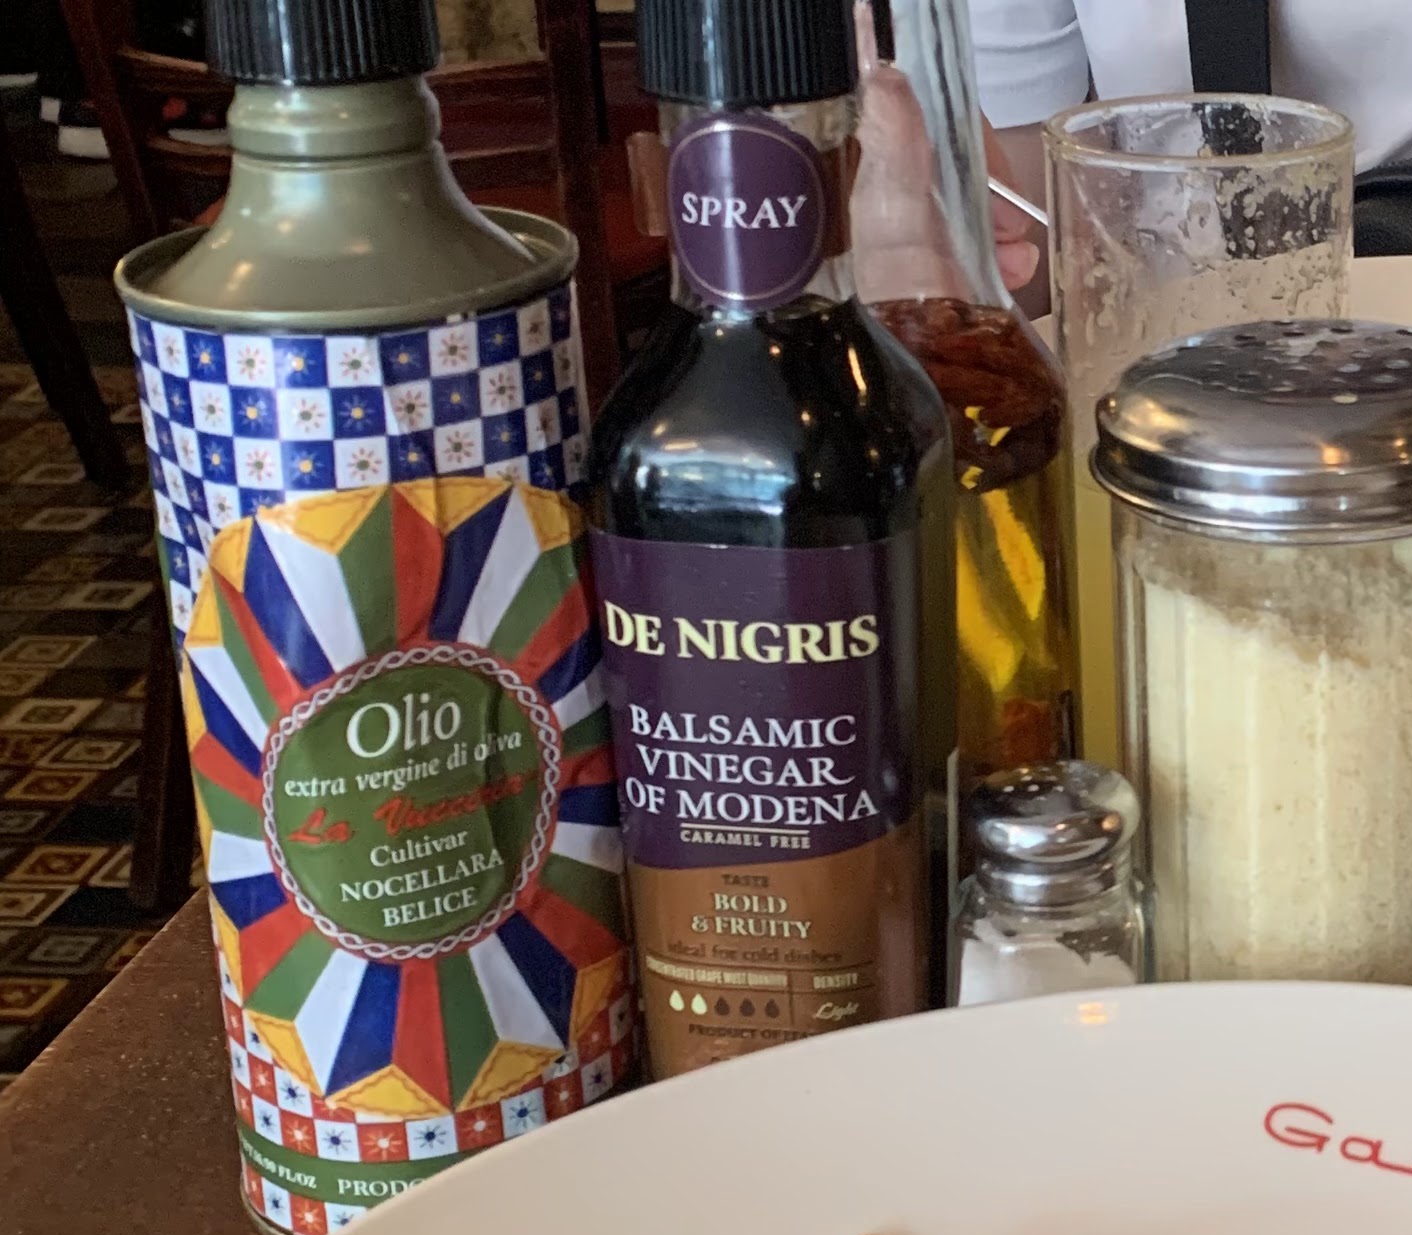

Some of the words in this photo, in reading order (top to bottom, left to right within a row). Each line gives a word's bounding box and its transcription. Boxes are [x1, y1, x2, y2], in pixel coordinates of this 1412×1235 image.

[682, 191, 808, 230] SPRAY
[604, 600, 665, 656] DE
[673, 614, 880, 664] NIGRIS
[346, 693, 461, 758] Olio
[628, 703, 857, 748] BALSAMIC
[284, 776, 346, 797] extra
[355, 757, 440, 791] vergine
[447, 742, 467, 770] di
[635, 743, 855, 787] VINEGAR
[625, 777, 666, 815] OF
[676, 789, 880, 825] MODENA
[370, 830, 468, 867] Cultivar
[680, 829, 762, 848] CARAMEL
[769, 835, 811, 849] FREE
[339, 848, 505, 902] NOCELLARA
[721, 873, 769, 888] TASTE
[382, 886, 478, 927] BELICE
[713, 892, 787, 914] BOLD
[691, 915, 709, 933] &
[714, 916, 811, 939] FRUITY
